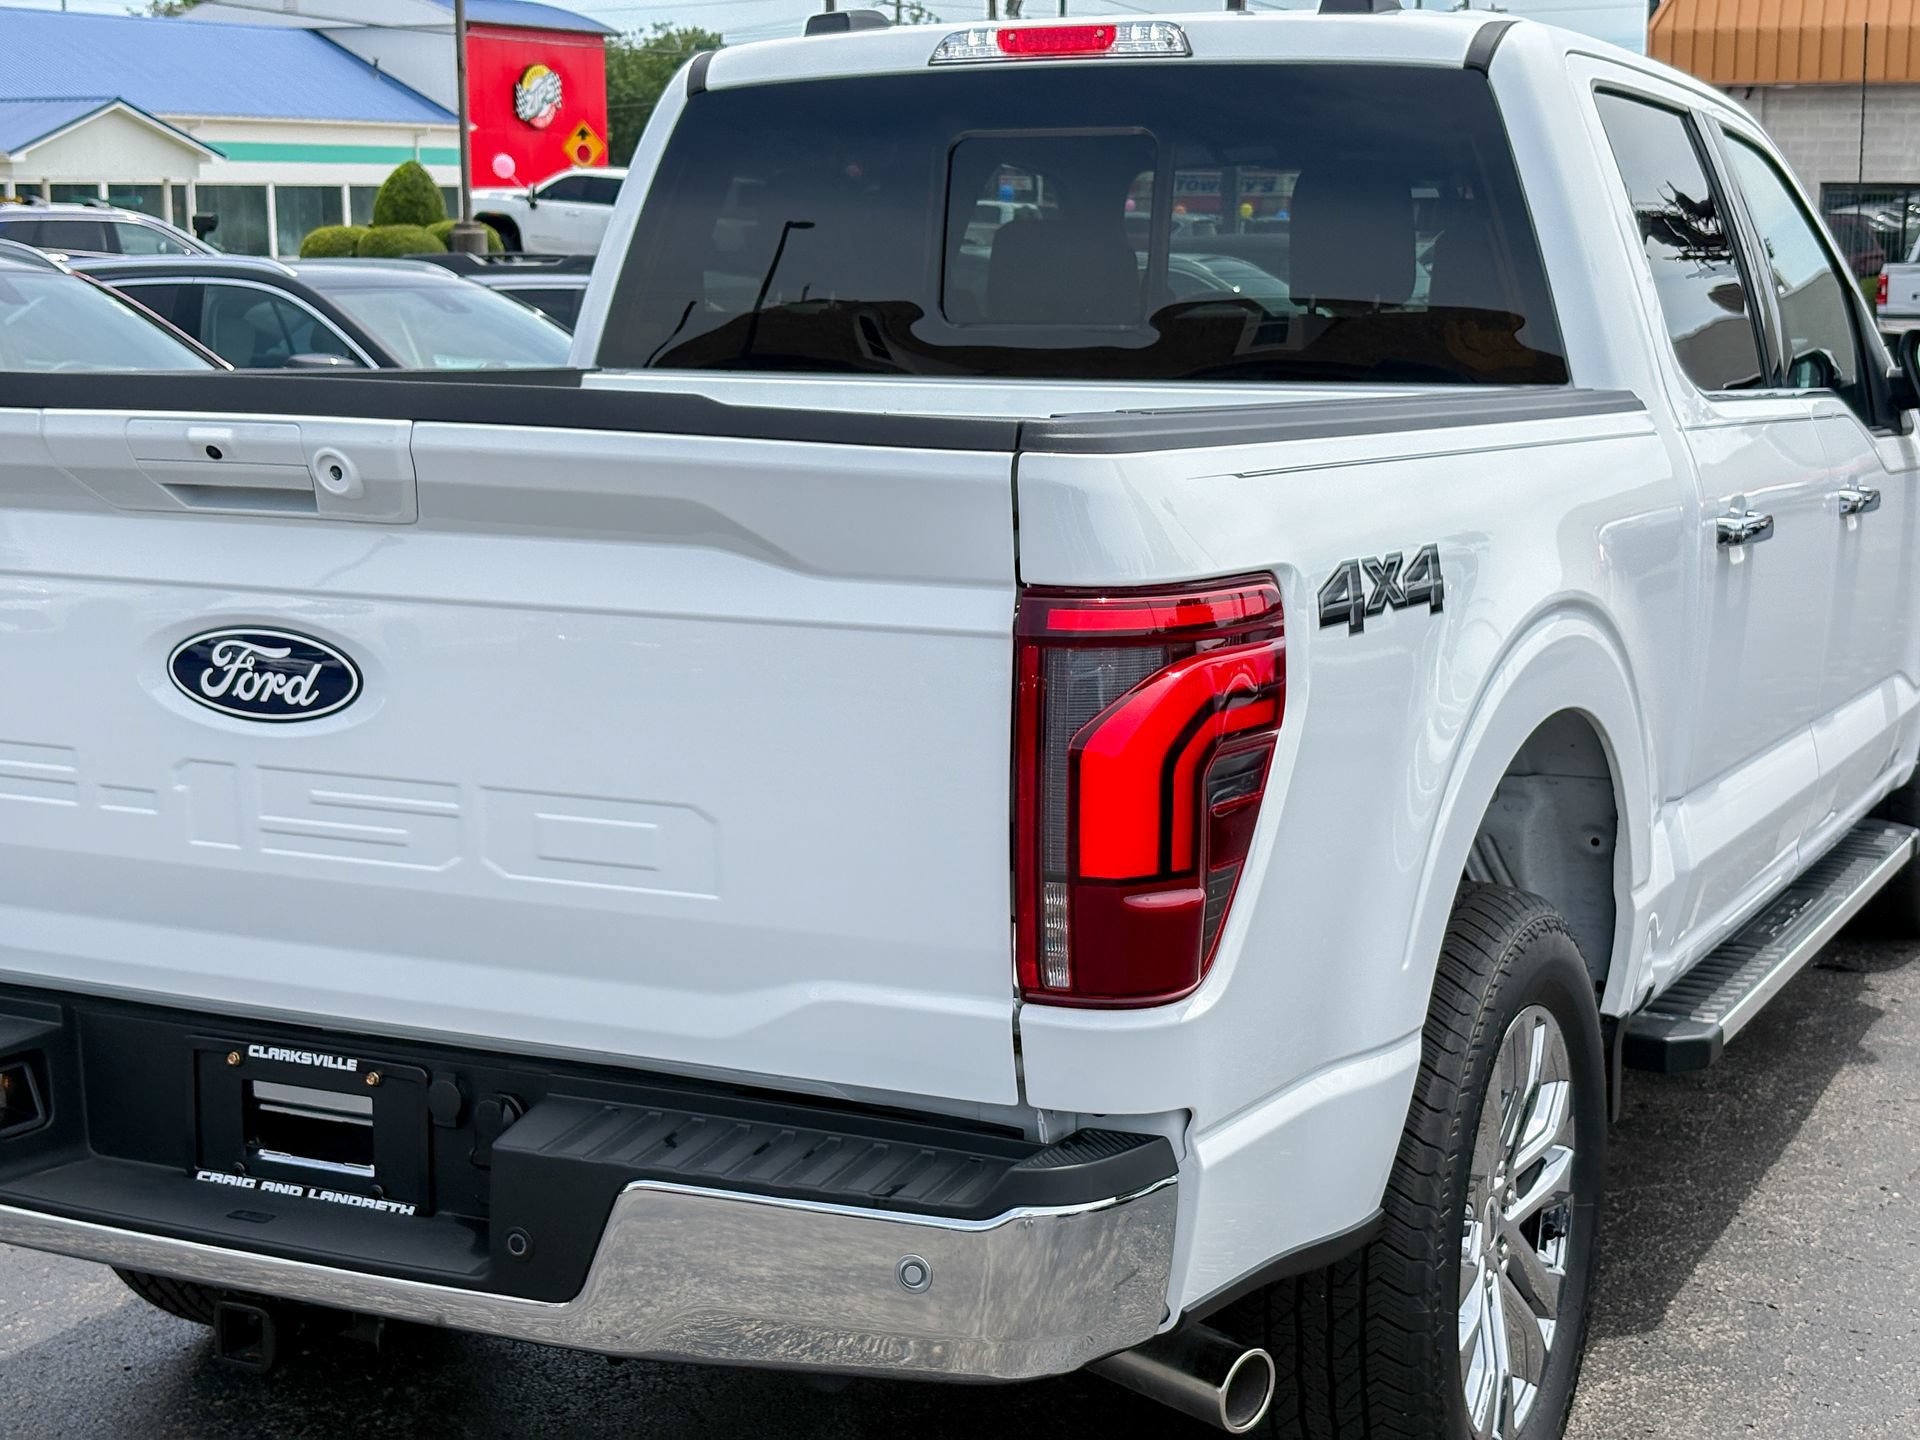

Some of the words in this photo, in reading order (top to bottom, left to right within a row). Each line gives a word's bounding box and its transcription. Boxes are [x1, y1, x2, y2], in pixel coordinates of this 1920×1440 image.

[200, 639, 323, 707] Ford
[248, 1044, 358, 1072] CLARKSVILLE
[196, 1171, 257, 1190] CRAIG
[260, 1180, 304, 1198] AND
[307, 1188, 416, 1216] LANDRETH
